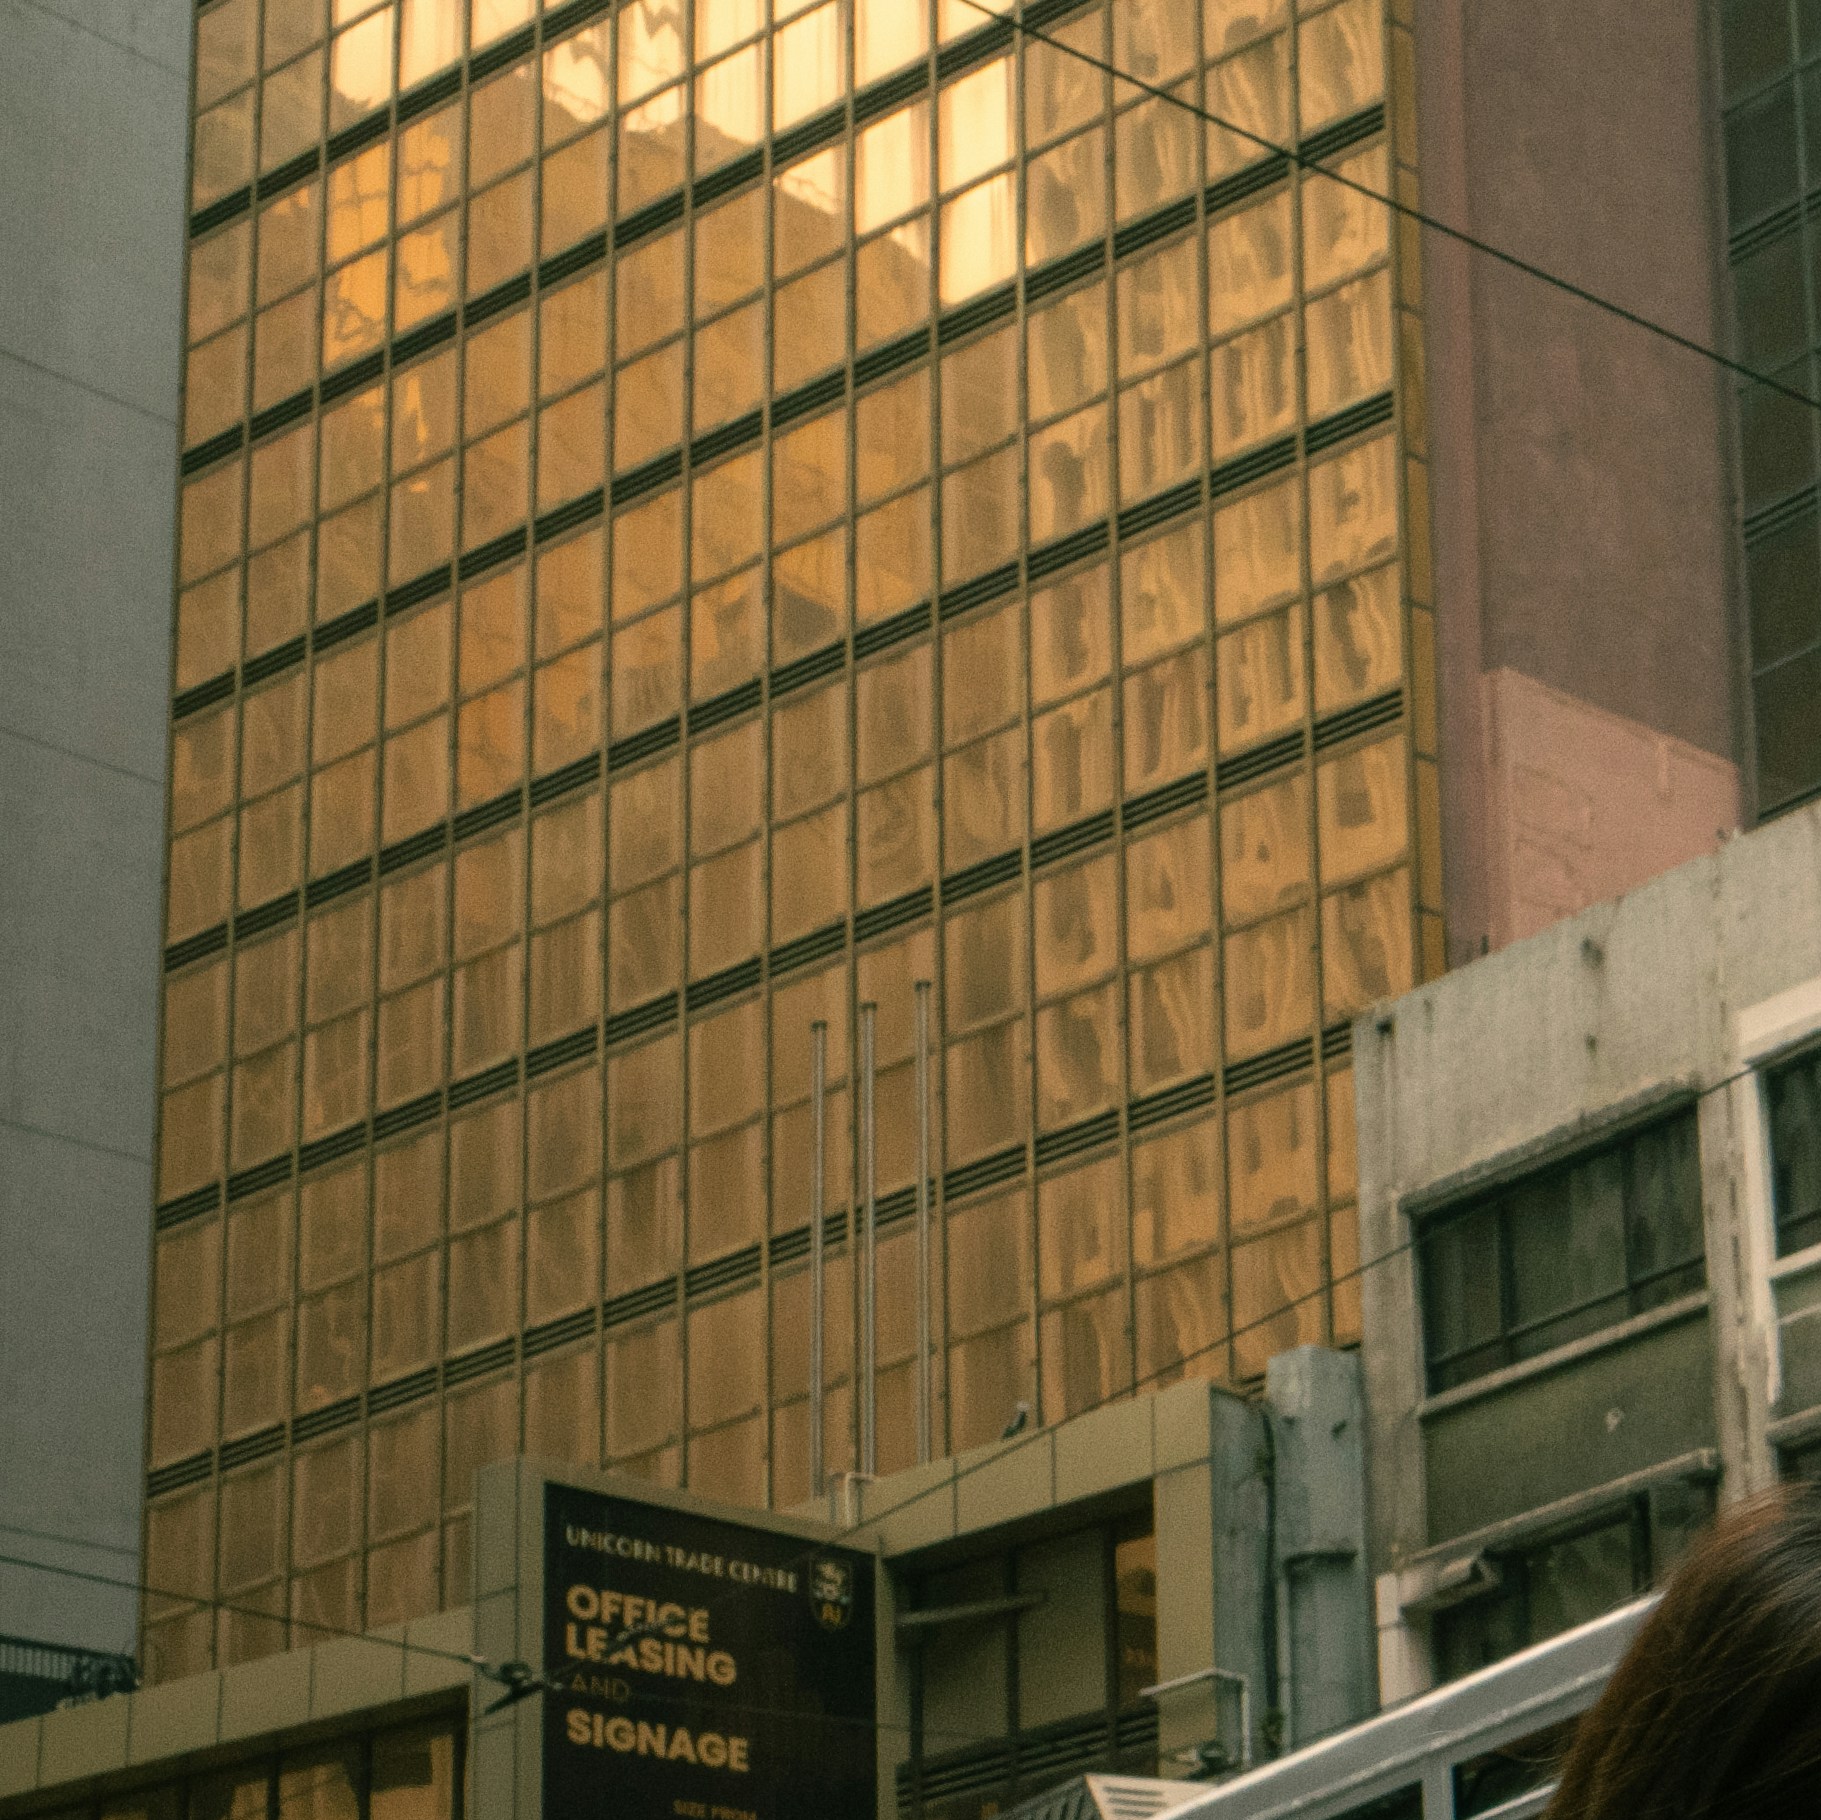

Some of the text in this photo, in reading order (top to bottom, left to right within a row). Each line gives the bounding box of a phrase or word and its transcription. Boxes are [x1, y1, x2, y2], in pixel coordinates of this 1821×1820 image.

[566, 1524, 798, 1593] UNICORN TRADE CENTRE
[566, 1584, 710, 1644] OFFICE
[566, 1623, 738, 1686] LEASING
[571, 1673, 632, 1701] AND
[566, 1708, 749, 1773] SIGNAGE
